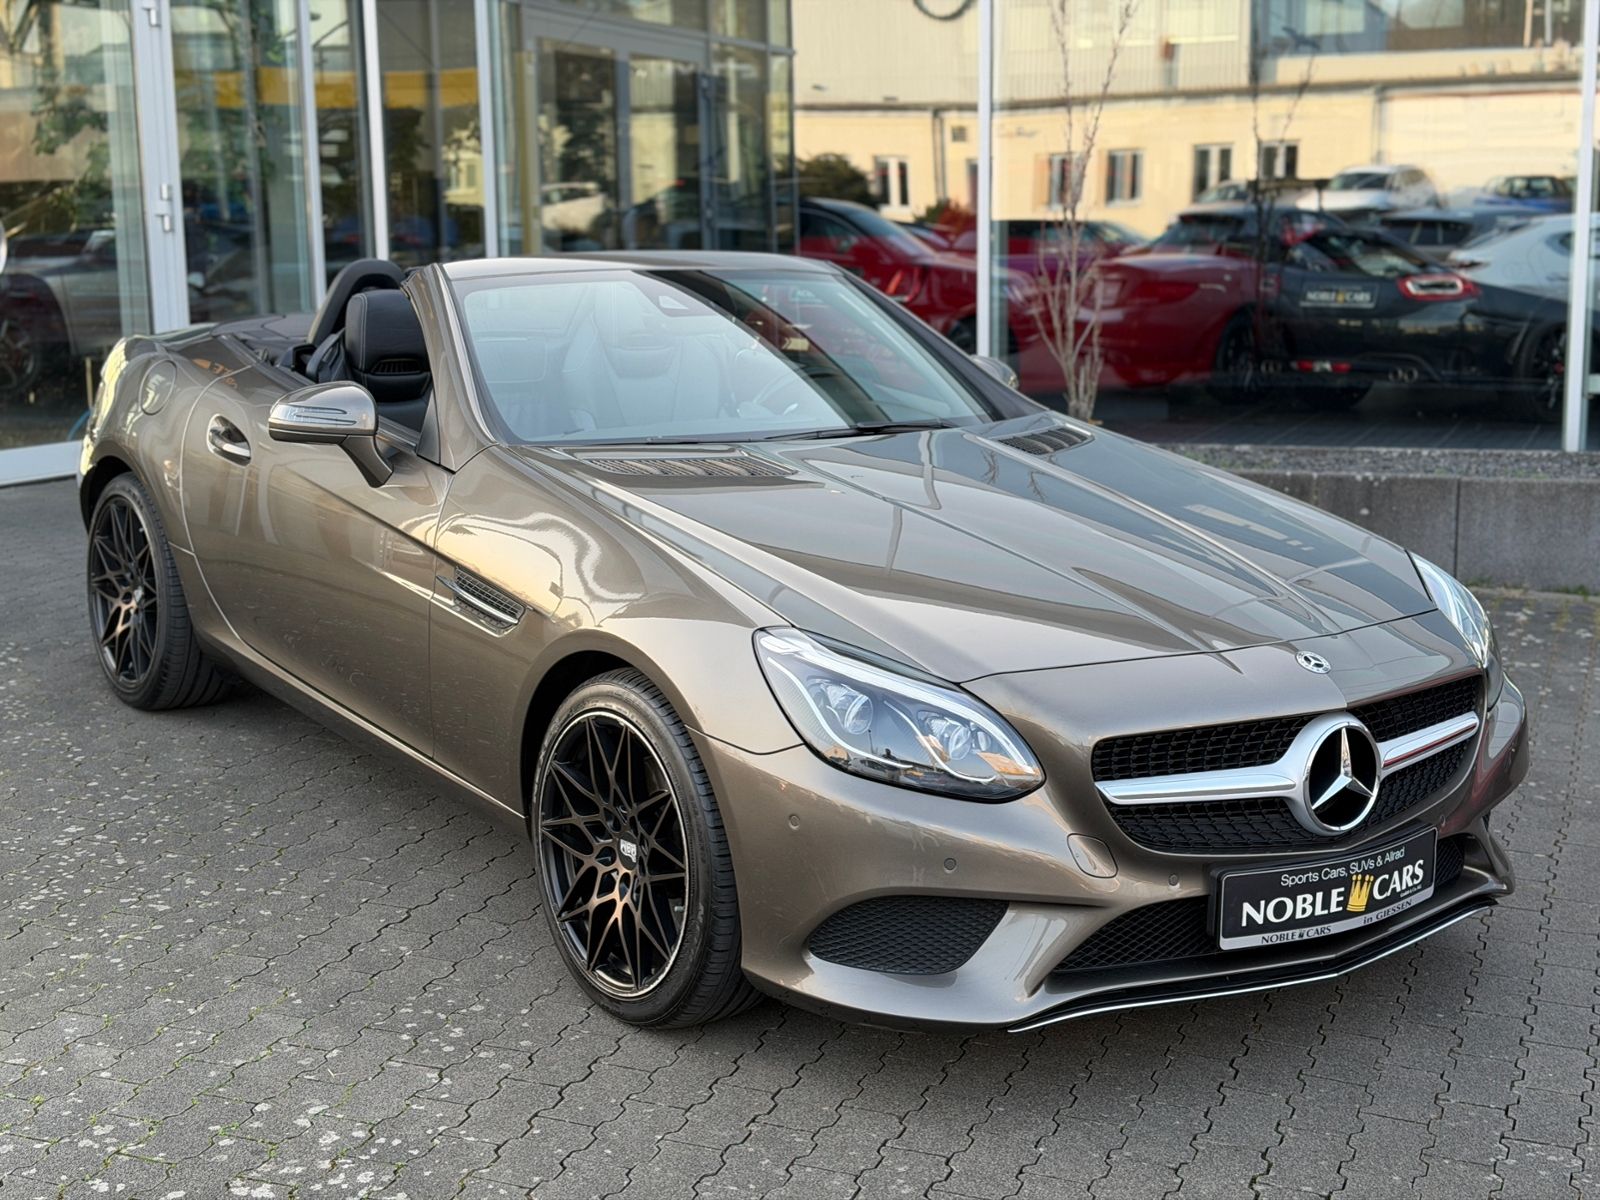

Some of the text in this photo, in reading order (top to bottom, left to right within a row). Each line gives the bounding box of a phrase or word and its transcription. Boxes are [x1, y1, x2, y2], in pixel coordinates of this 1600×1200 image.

[1280, 847, 1405, 887] Sports Cars, SUVs & Allrad
[1241, 859, 1424, 927] NOBLE CARS
[1363, 899, 1412, 925] in GIESSEN
[1261, 925, 1332, 944] NOBLE CARS
